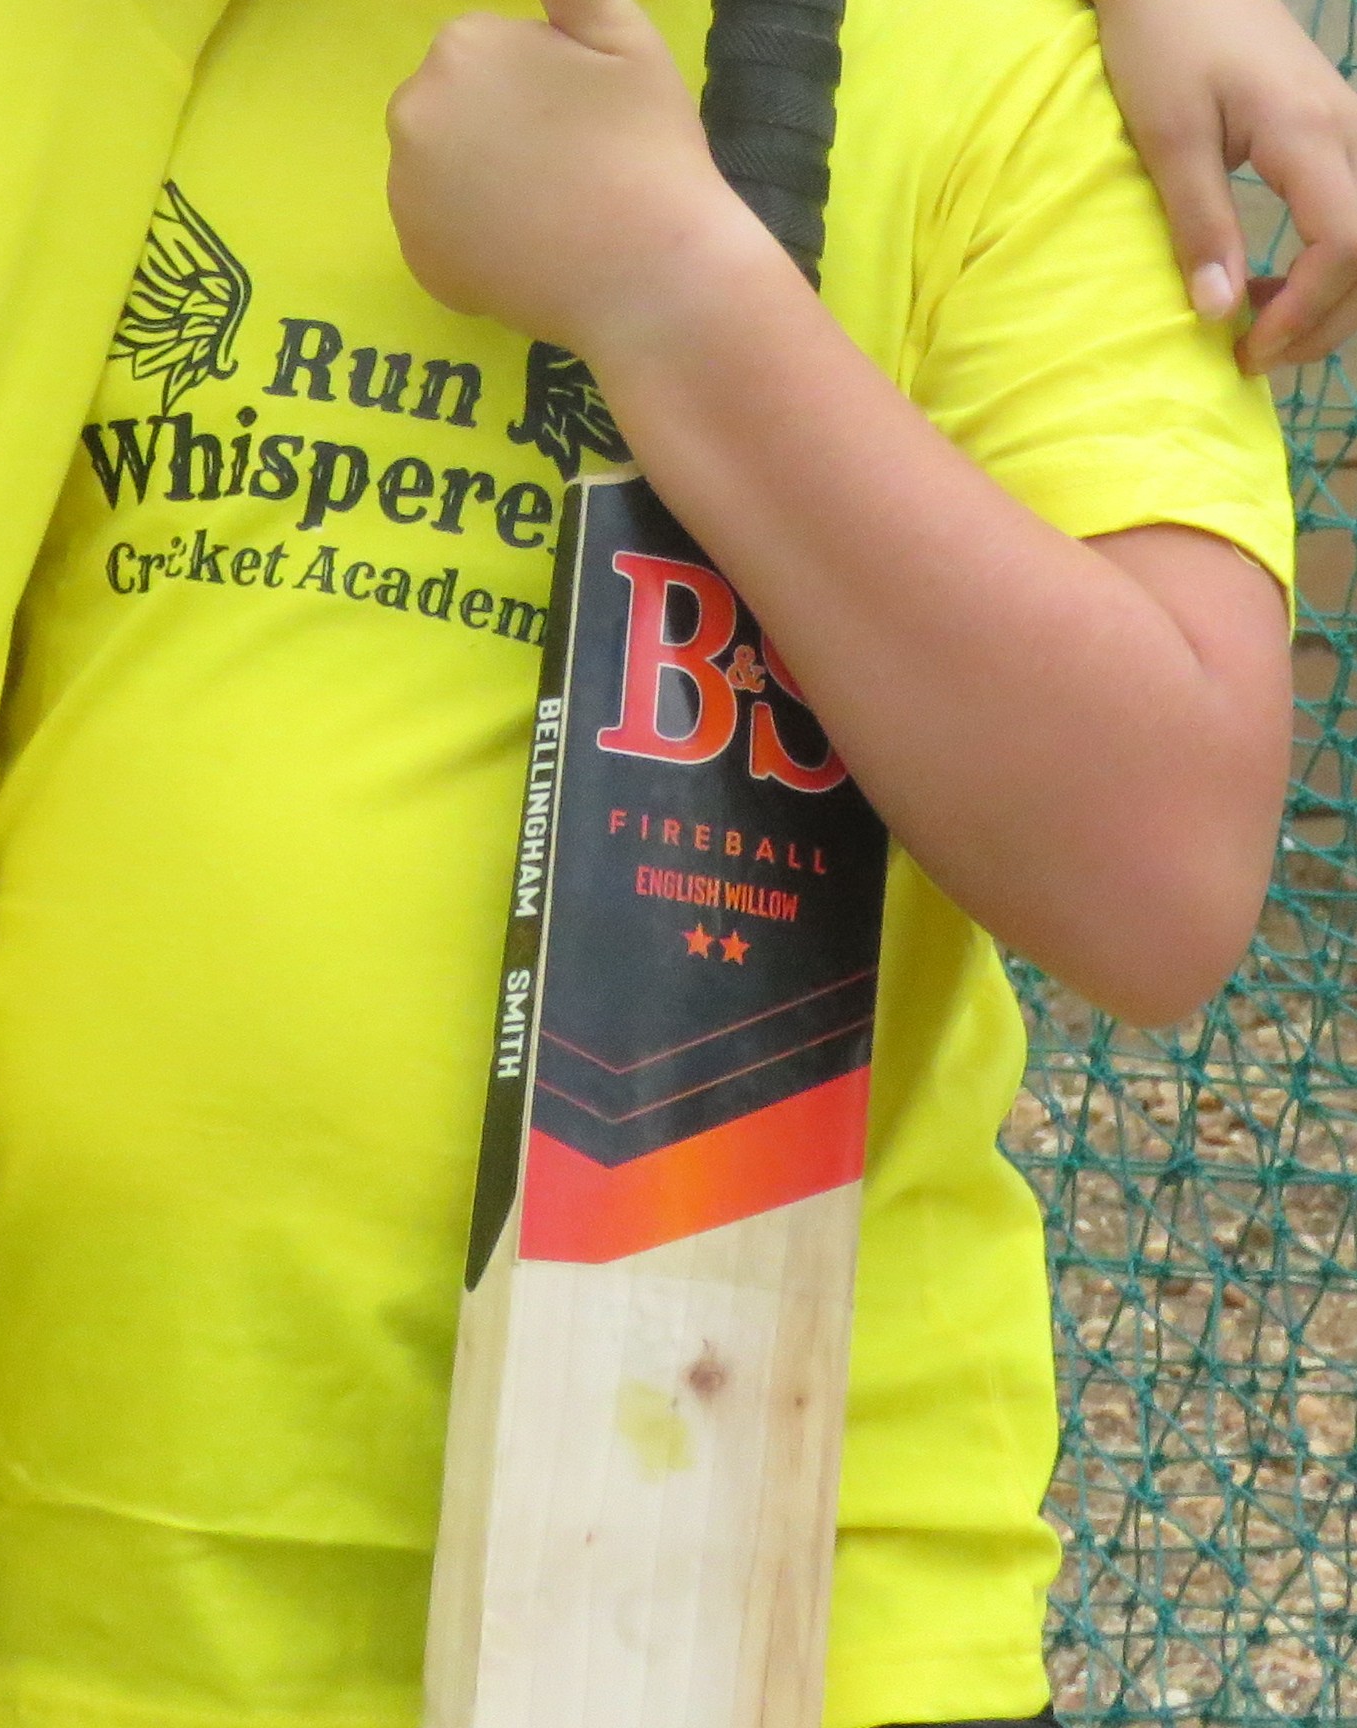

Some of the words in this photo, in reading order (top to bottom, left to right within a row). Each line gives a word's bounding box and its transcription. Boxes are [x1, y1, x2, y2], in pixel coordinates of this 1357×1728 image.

[262, 317, 484, 428] Run
[81, 406, 558, 556] Whispere
[292, 545, 548, 648] Academ
[515, 696, 562, 919] BELLINGHAM
[608, 808, 827, 875] FIREBALL
[634, 864, 720, 908] ENGLISH
[724, 881, 801, 922] WILLOW
[497, 968, 531, 1080] SMITH
